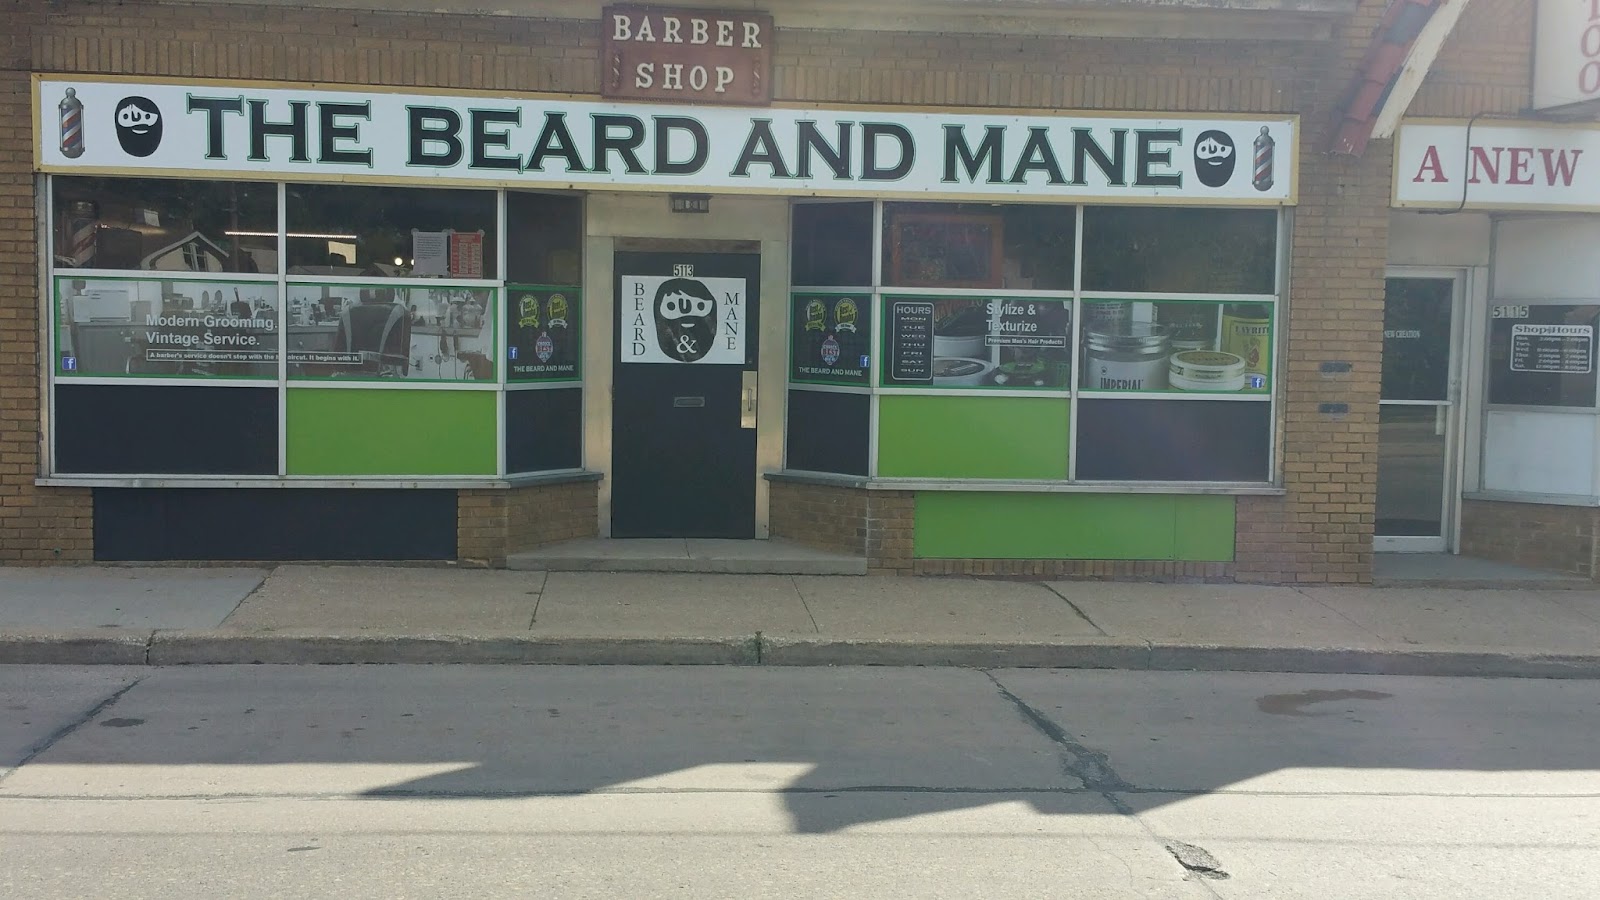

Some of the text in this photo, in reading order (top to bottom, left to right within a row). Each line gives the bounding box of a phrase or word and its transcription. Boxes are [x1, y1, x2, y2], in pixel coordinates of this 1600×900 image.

[613, 15, 762, 48] BARBER
[635, 63, 734, 93] SHOP
[186, 93, 1183, 189] THE BEARD AND MANE
[1412, 145, 1584, 187] A NEW
[674, 265, 694, 277] 5113
[896, 306, 931, 314] HOURS
[986, 302, 1024, 317] Stylize
[1027, 304, 1036, 315] &
[1493, 306, 1528, 317] 5115
[146, 314, 278, 331] Modern Grooming.
[632, 282, 646, 356] BEARD
[724, 292, 740, 350] MANE
[986, 320, 1037, 332] Texturize
[146, 331, 261, 346] Vintage Service.
[1515, 326, 1547, 334] Shop
[676, 334, 697, 354] &
